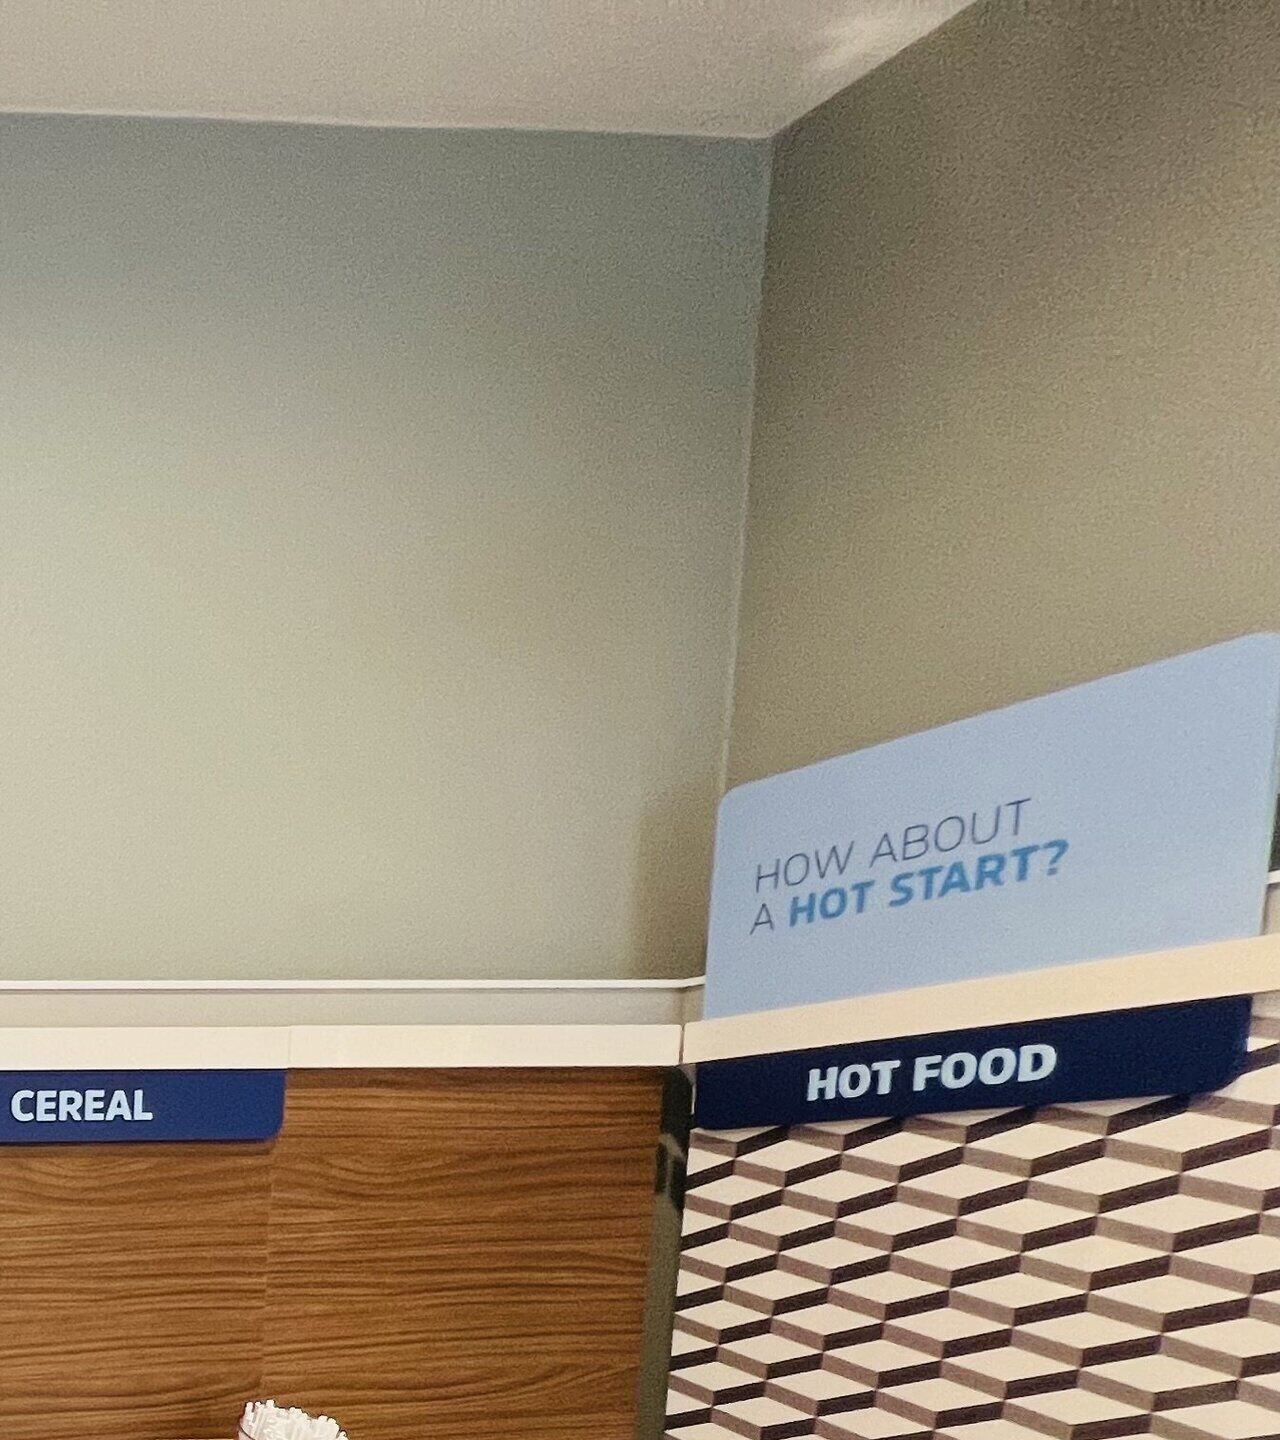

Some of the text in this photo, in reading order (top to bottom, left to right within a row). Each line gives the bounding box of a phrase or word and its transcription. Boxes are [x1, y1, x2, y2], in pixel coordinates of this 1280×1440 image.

[755, 798, 1033, 894] HOW ABOUT
[749, 838, 1070, 935] A HOT START?
[10, 1089, 154, 1123] CEREAL
[806, 1043, 1059, 1102] HOT FOOD
